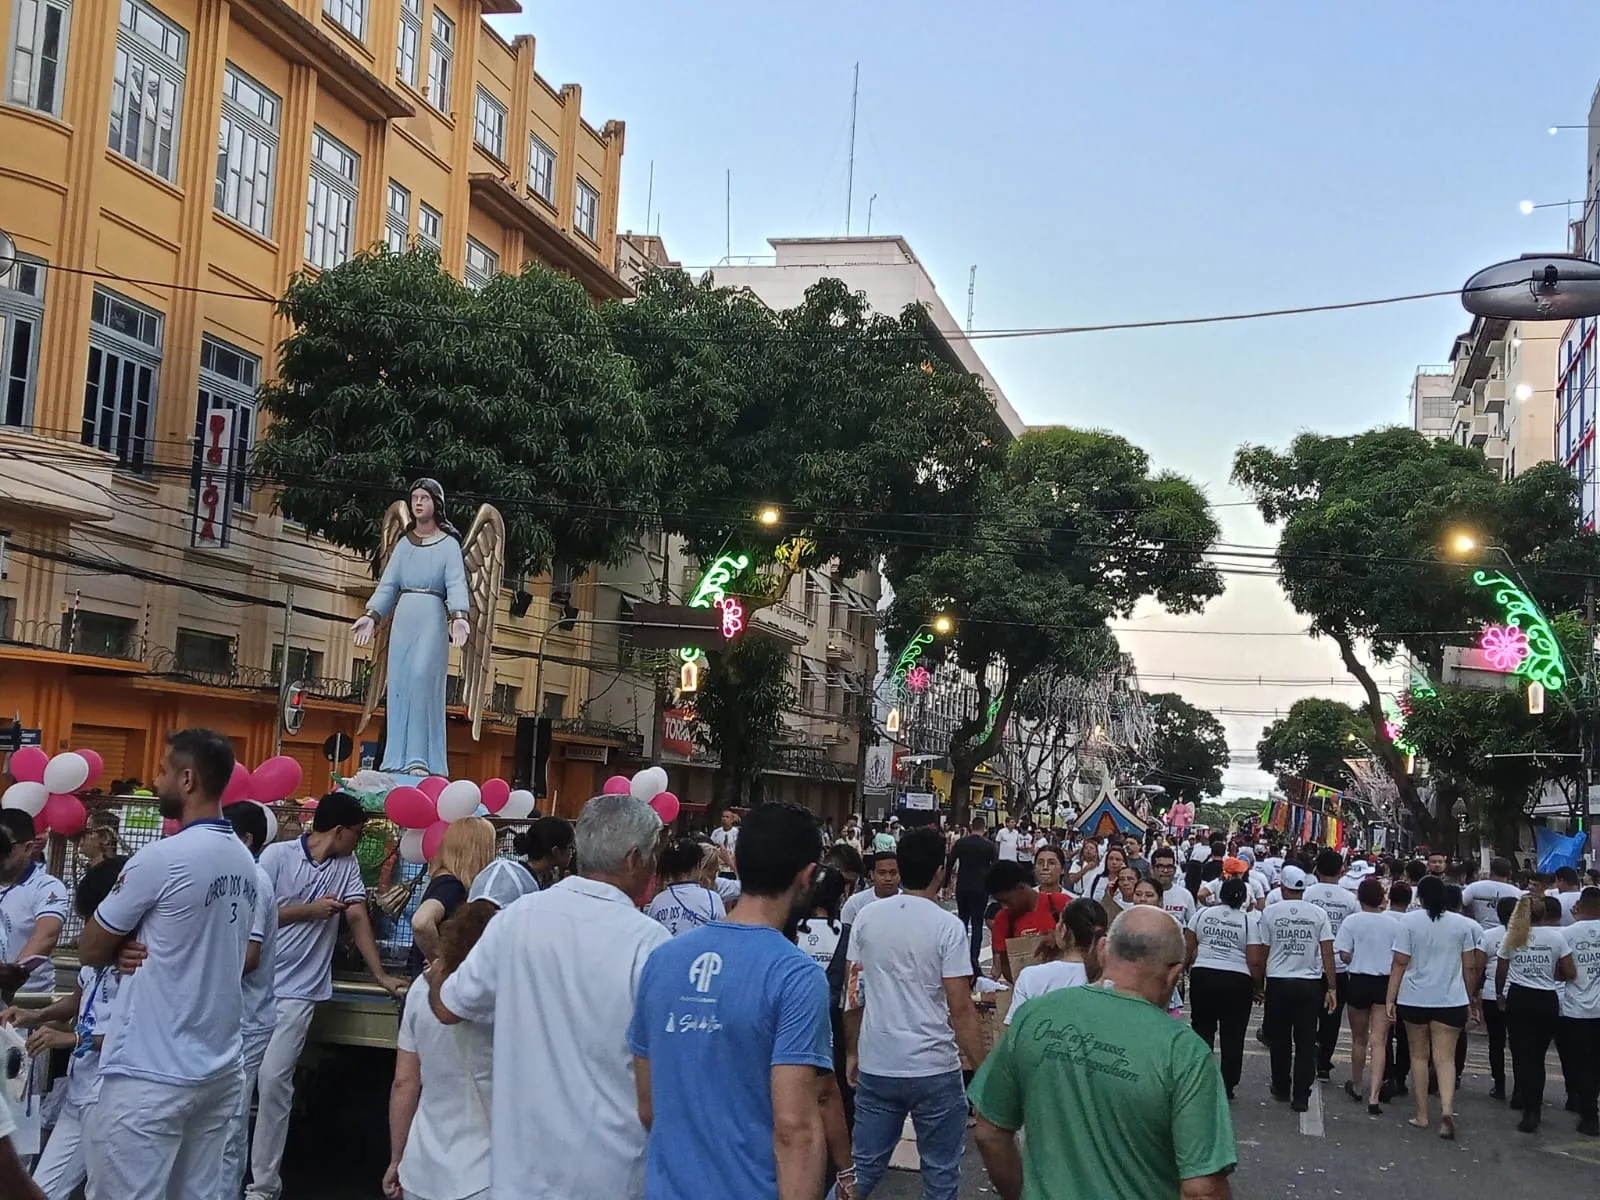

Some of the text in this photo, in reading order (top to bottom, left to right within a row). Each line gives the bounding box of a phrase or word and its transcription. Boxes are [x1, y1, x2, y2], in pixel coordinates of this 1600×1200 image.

[199, 414, 226, 540] BIG LOJA
[229, 874, 242, 897] DOS
[229, 902, 238, 924] 3
[669, 906, 681, 920] DOS
[671, 922, 677, 935] 3
[1203, 926, 1239, 940] GUARDA
[1276, 929, 1313, 940] GUARDA
[1282, 943, 1306, 951] APOIO
[1514, 955, 1550, 964] GUARDA
